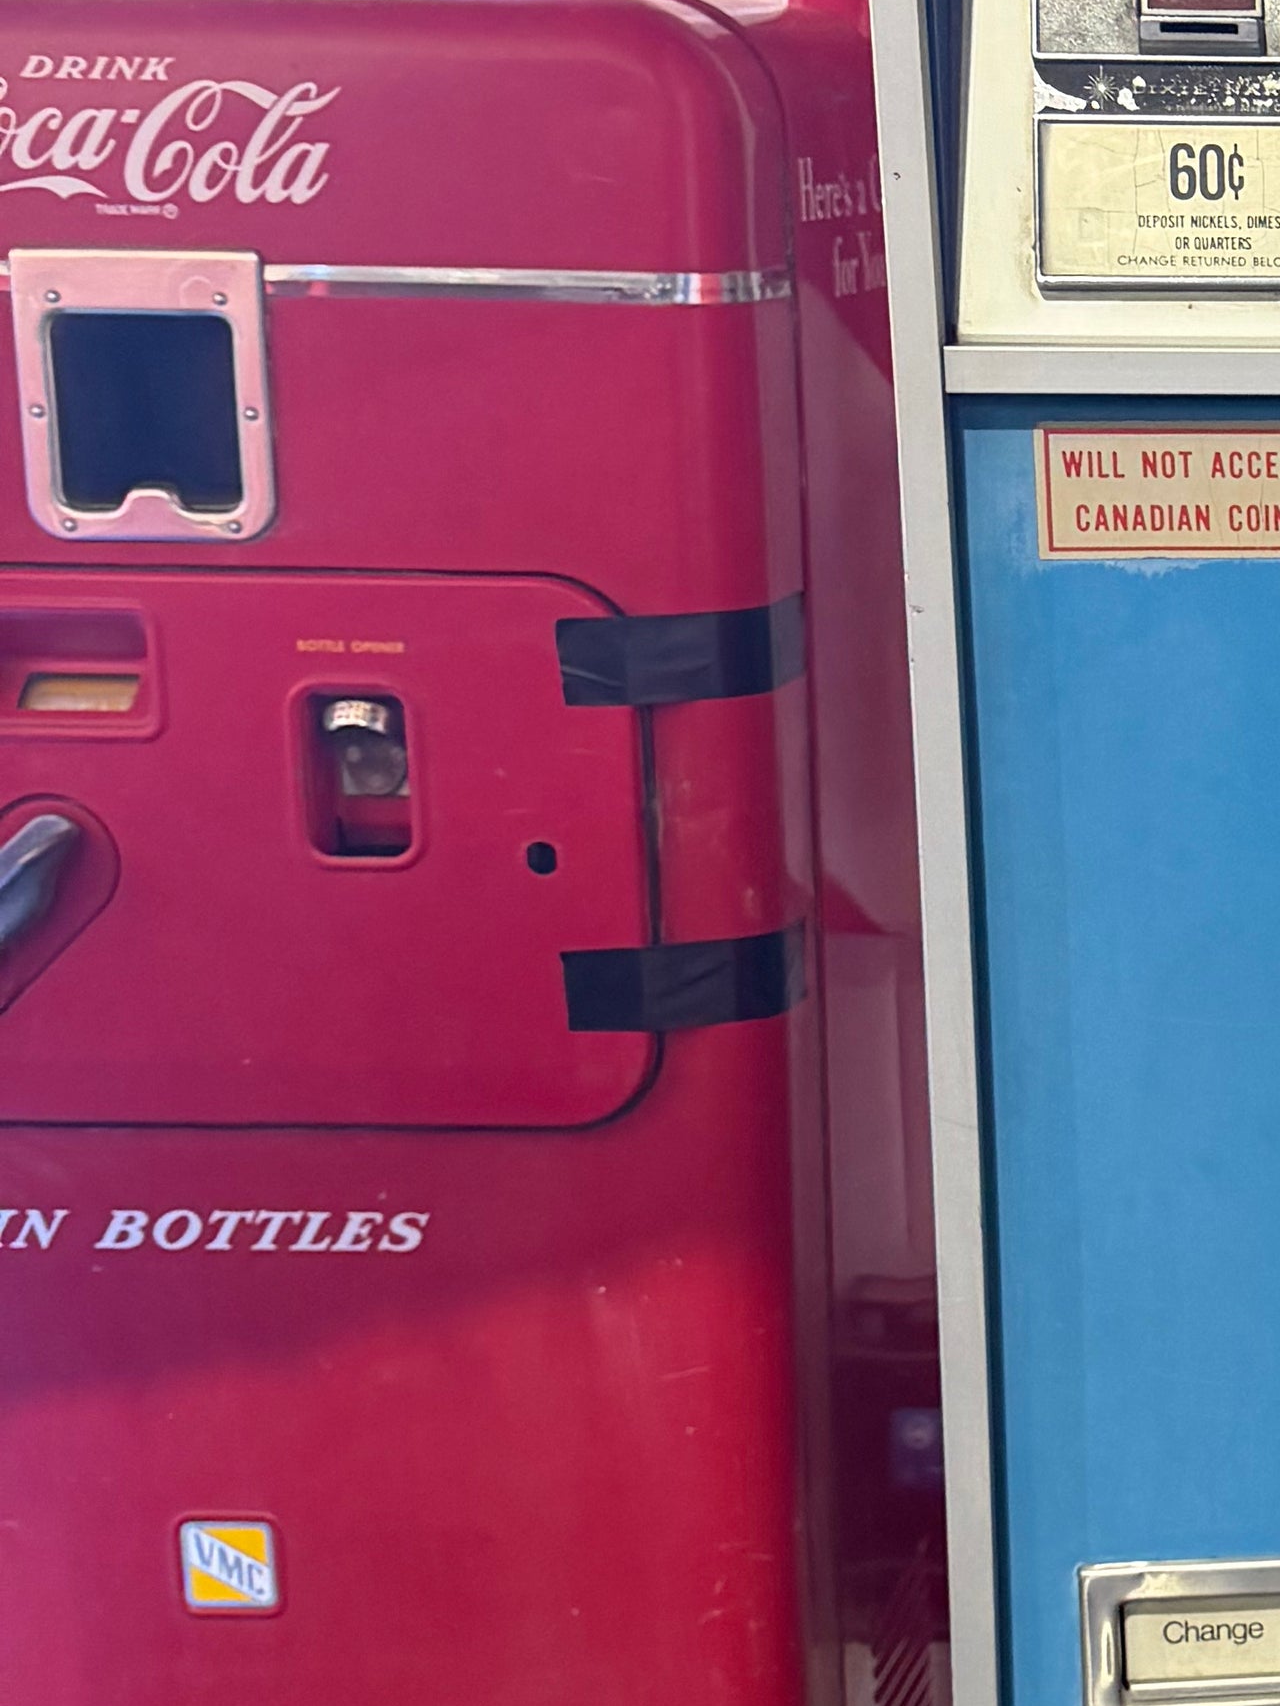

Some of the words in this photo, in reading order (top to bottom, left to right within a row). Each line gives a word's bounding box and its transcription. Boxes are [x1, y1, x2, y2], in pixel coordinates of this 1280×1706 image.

[20, 55, 176, 80] DRINK
[1169, 143, 1245, 200] 60¢
[798, 156, 853, 222] Here's
[1138, 215, 1185, 229] DEPOSIT
[1190, 215, 1242, 231] NICKELS,
[1175, 237, 1190, 250] OR
[1194, 236, 1252, 251] QUARTERS
[1117, 254, 1177, 267] CHANGE
[1183, 256, 1247, 268] RETURNED
[1062, 450, 1125, 479] WILL
[1141, 450, 1193, 479] NOT
[1075, 504, 1211, 532] CANADIAN
[0, 1209, 70, 1249] IN
[93, 1209, 430, 1252] BOTTLES
[193, 1532, 266, 1596] VMC
[1162, 1620, 1264, 1644] Change
